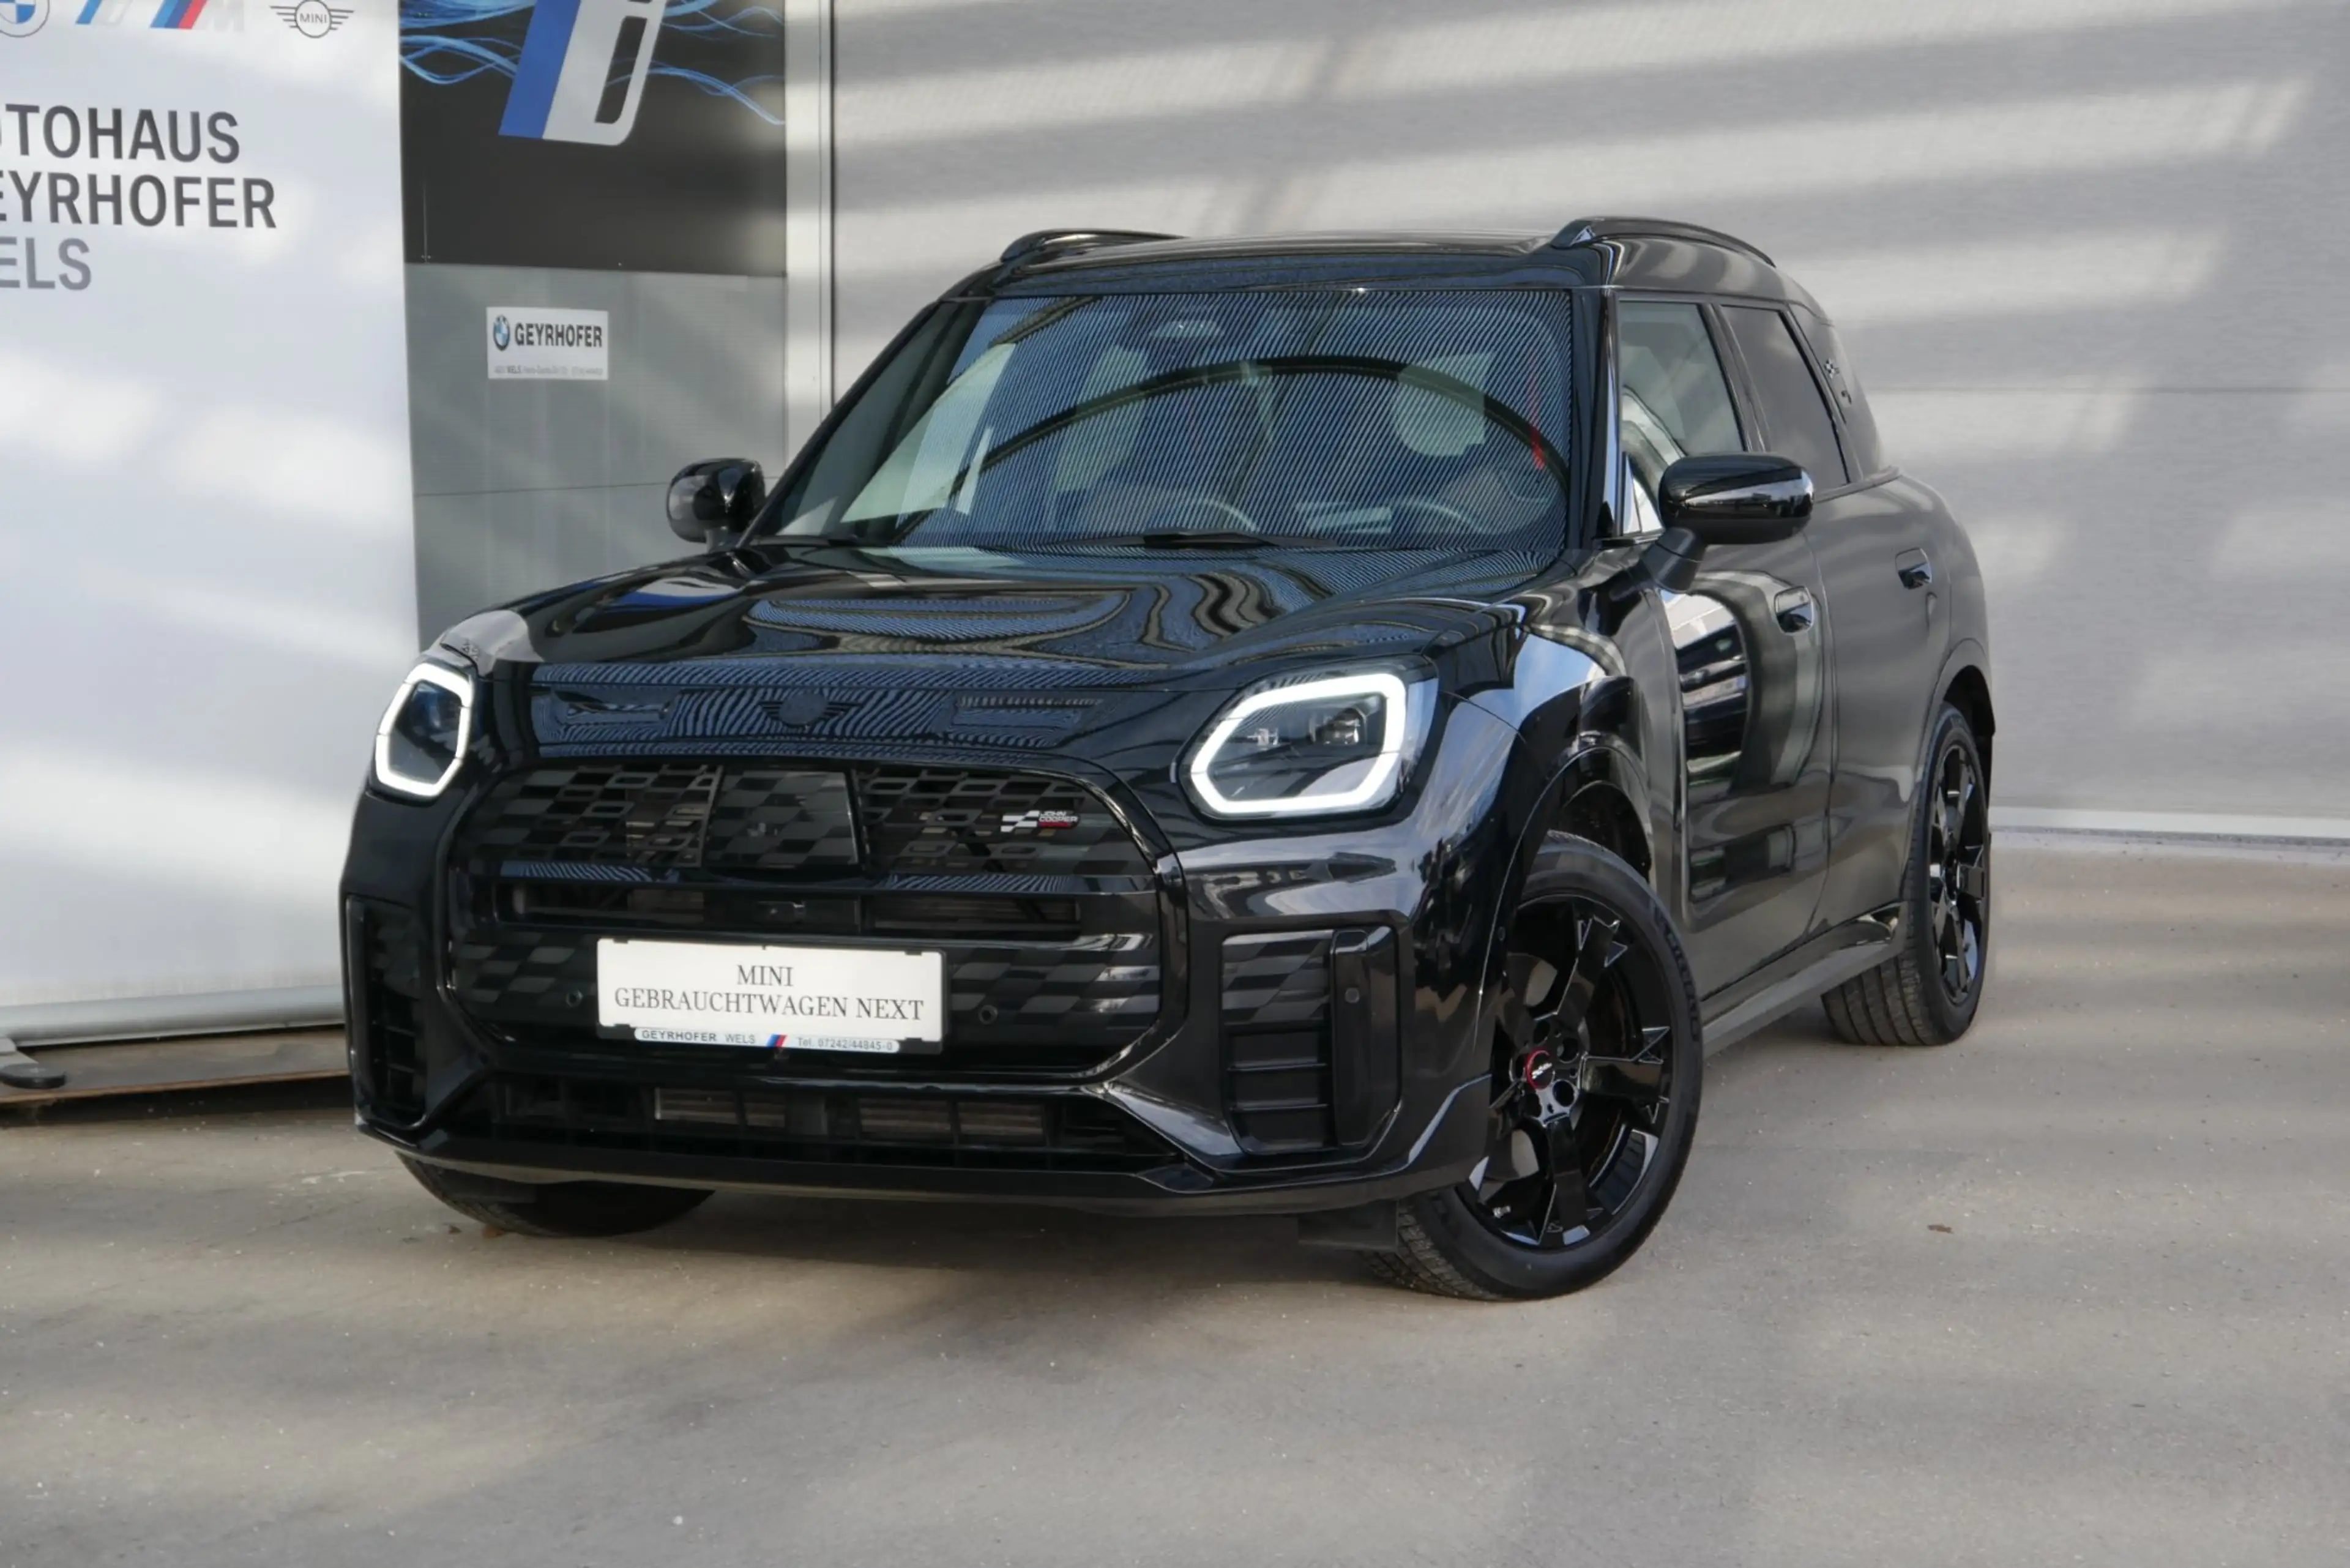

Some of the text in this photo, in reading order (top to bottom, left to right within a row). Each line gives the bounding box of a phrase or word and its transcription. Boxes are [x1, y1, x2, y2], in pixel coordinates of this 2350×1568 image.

[300, 12, 327, 24] MINI
[0, 103, 240, 164] TOHAUS
[0, 170, 277, 229] YRHOFER
[514, 322, 602, 348] GEYRHOFER
[737, 965, 794, 987] MINI
[614, 987, 925, 1021] GEBRAUCHTWAGEN NEXT
[641, 1029, 717, 1042] GEYRHOFER
[725, 1034, 756, 1044] WELS
